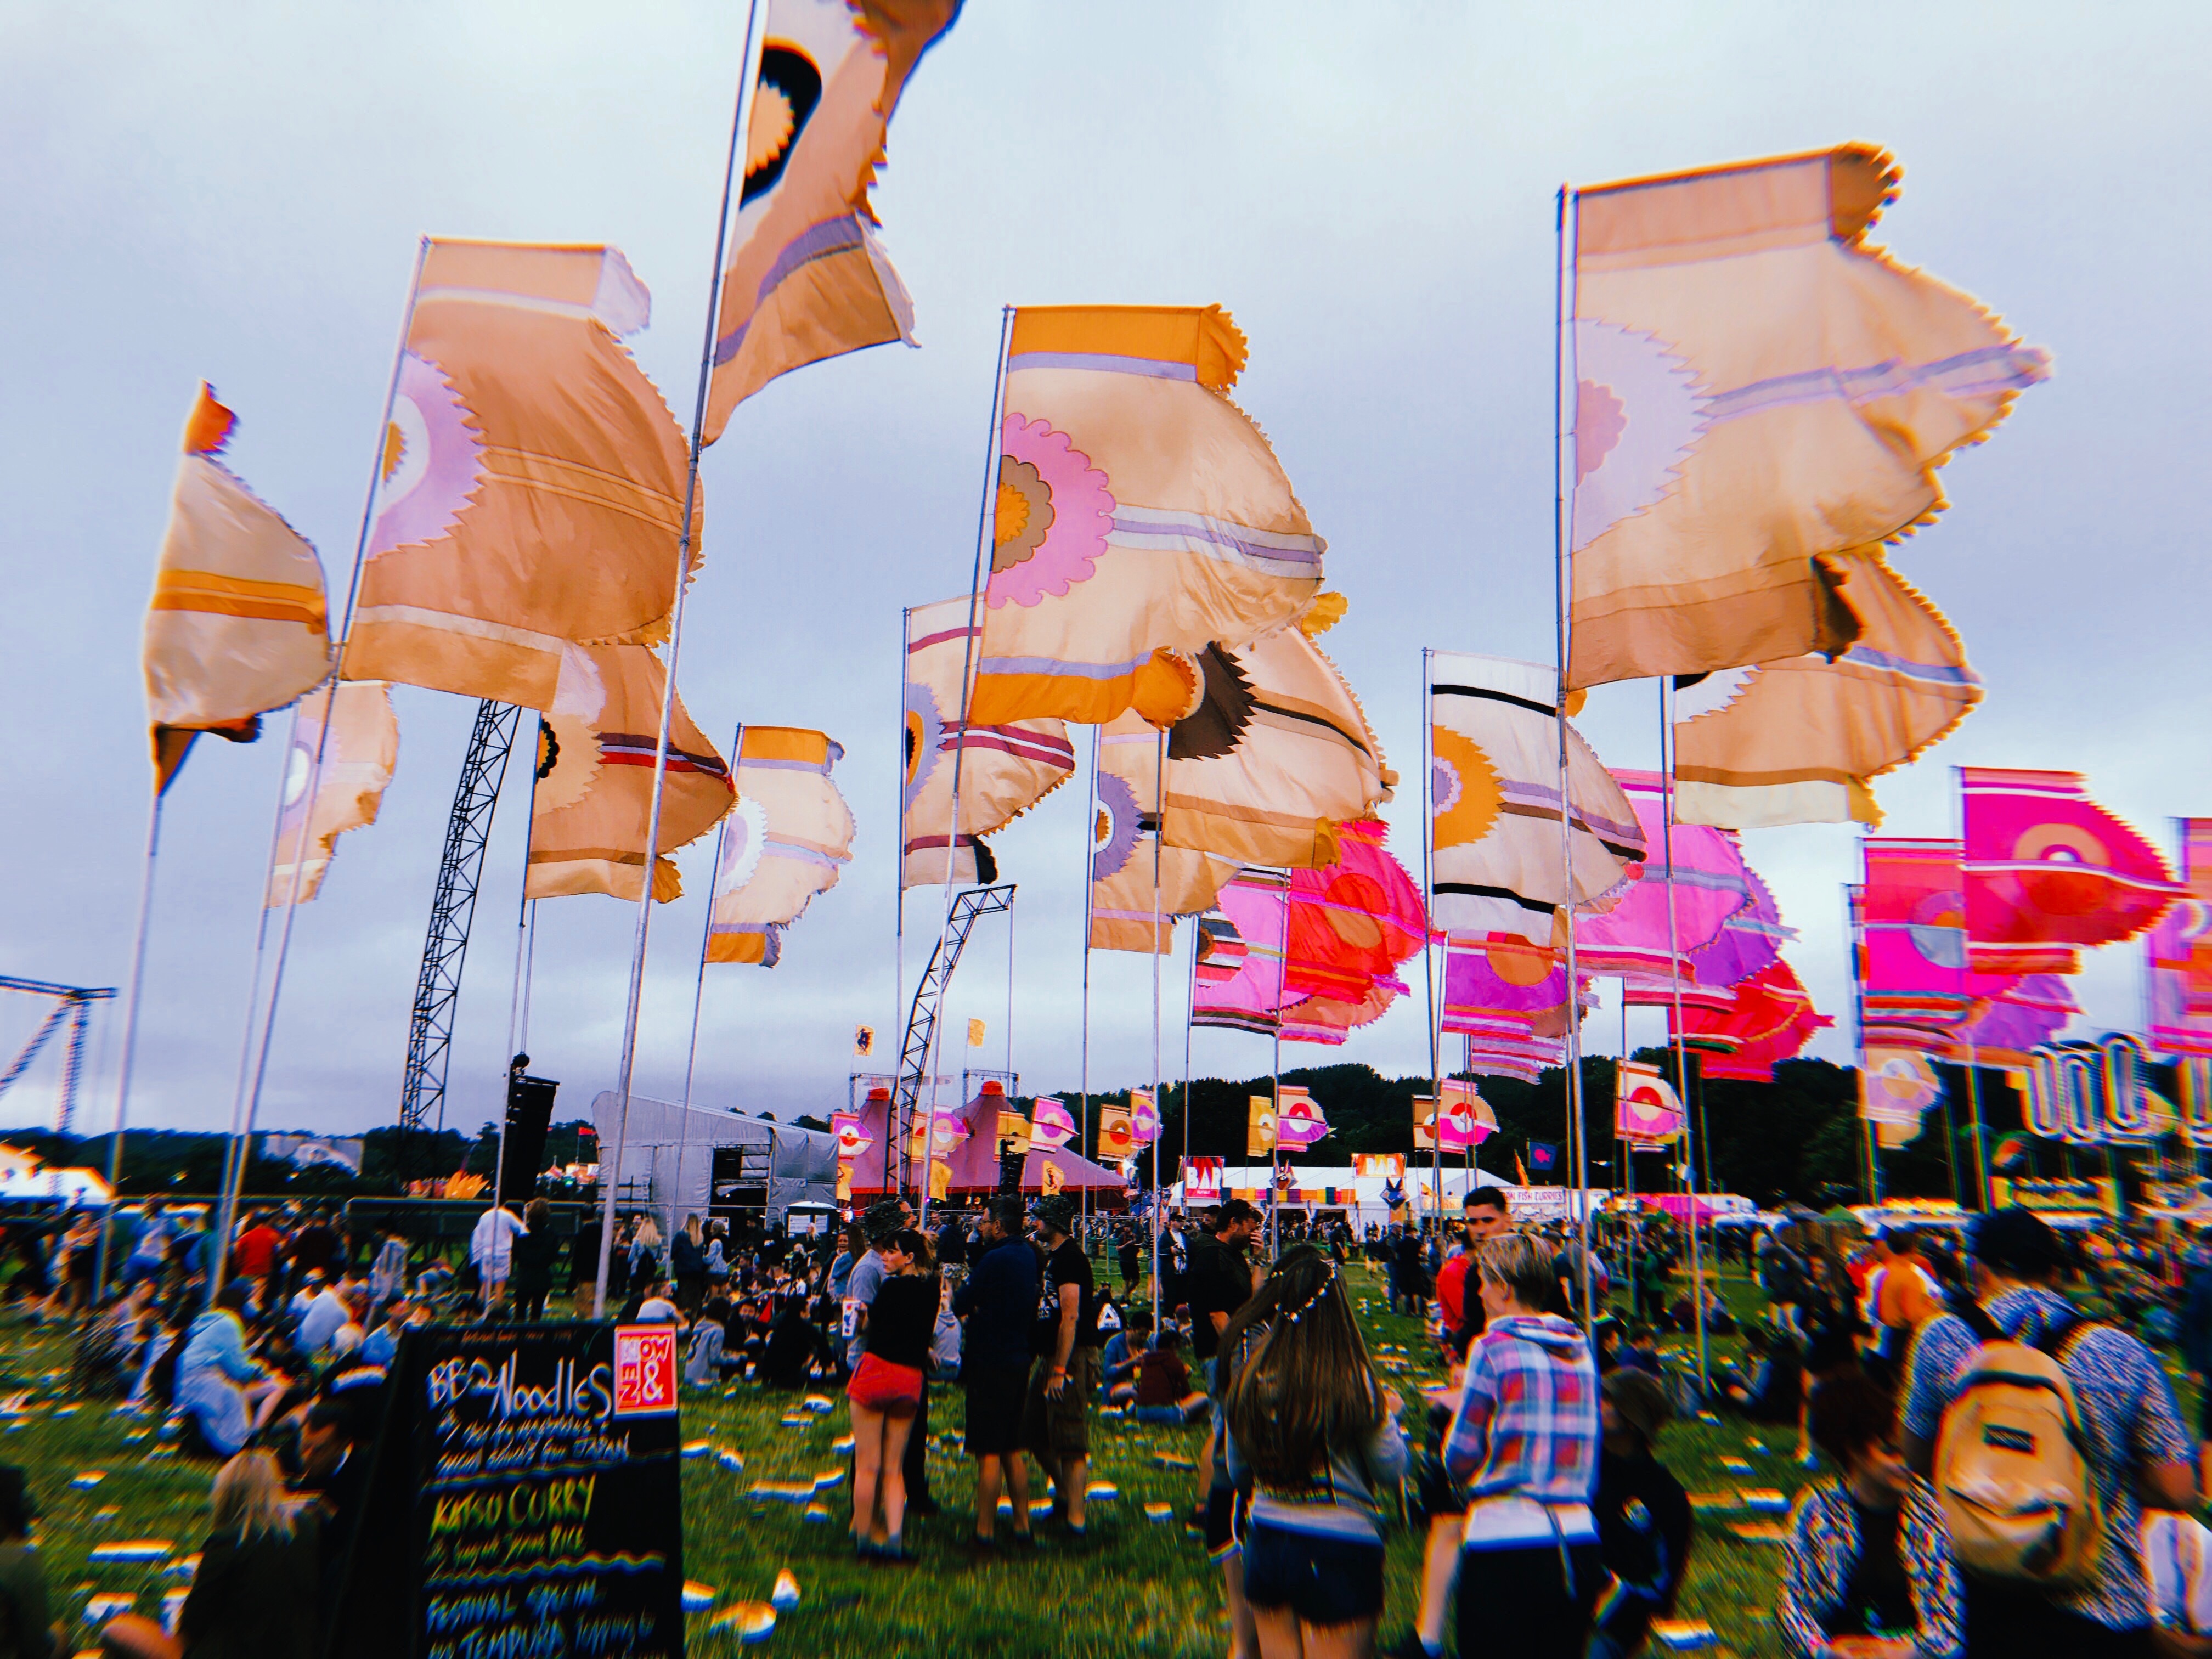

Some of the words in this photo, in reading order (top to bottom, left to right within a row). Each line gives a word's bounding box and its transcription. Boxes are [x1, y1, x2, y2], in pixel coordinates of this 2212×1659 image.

[1367, 1157, 1396, 1175] BAR
[1187, 1166, 1222, 1189] BAR
[1517, 1191, 1533, 1201] FISH
[1535, 1191, 1563, 1201] CURRIES
[507, 1474, 596, 1528] CURRY
